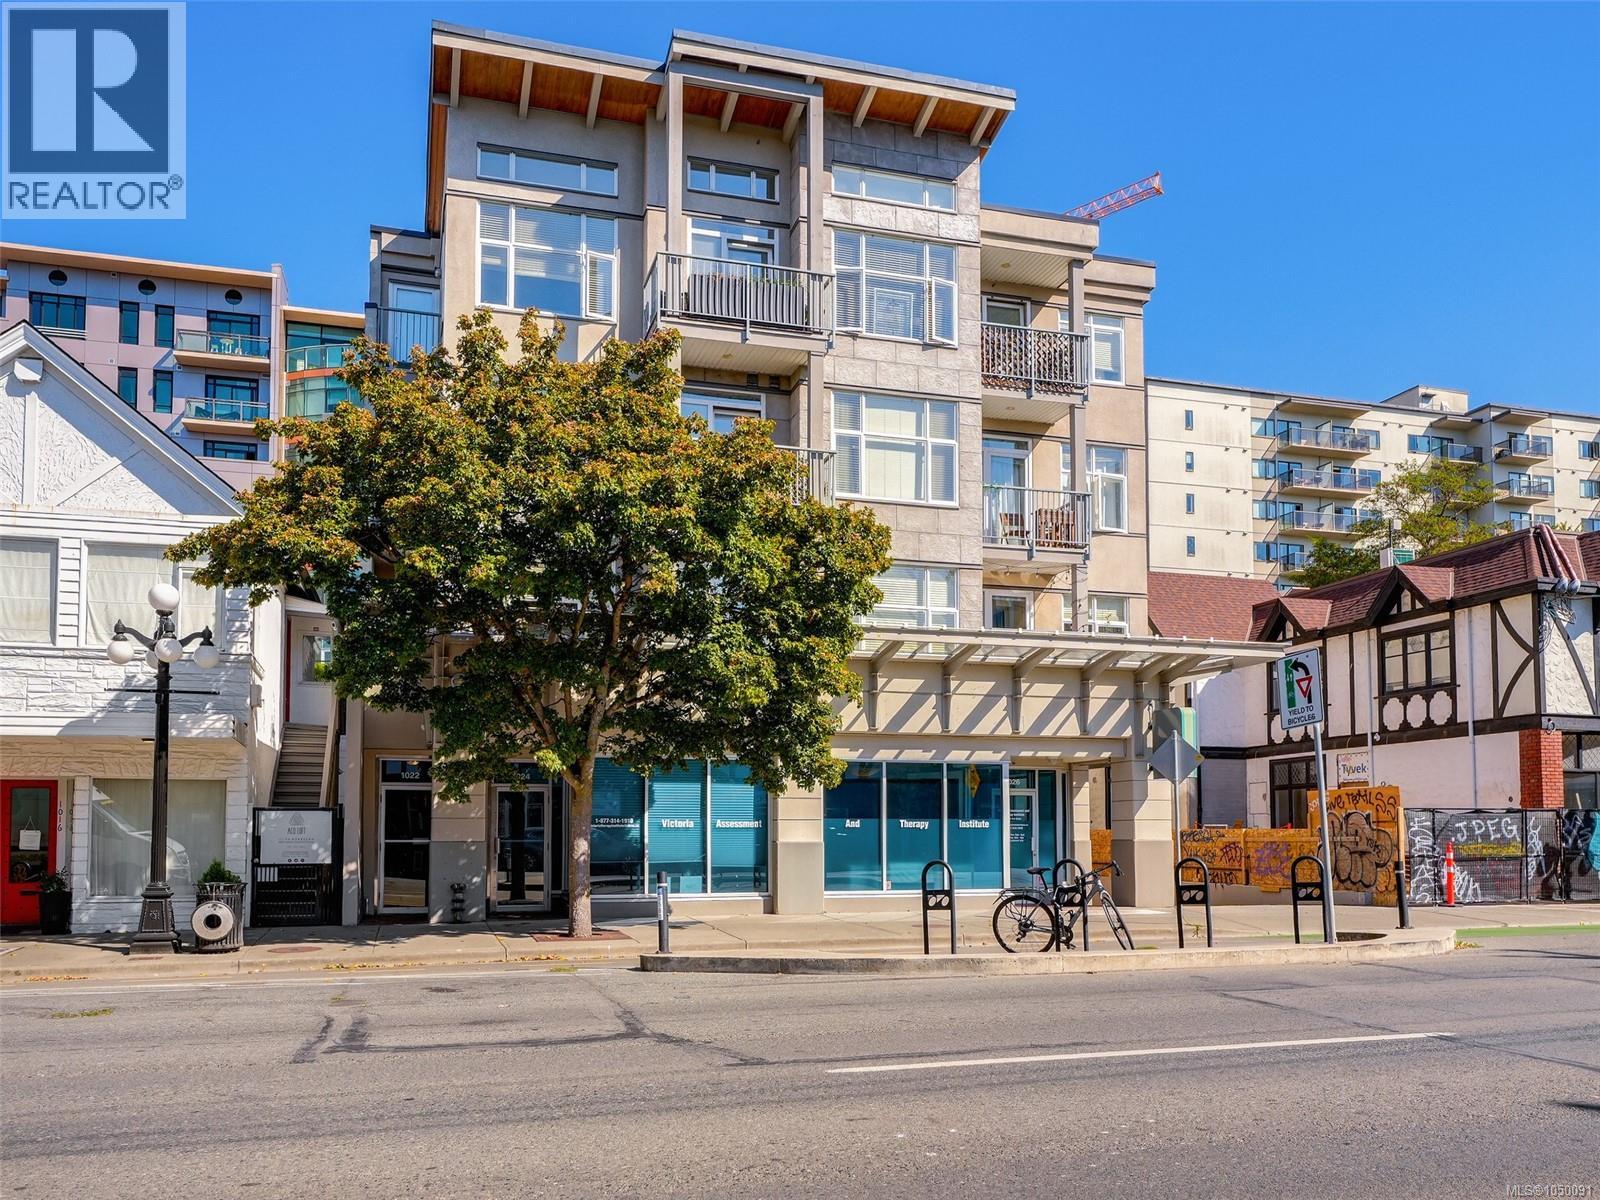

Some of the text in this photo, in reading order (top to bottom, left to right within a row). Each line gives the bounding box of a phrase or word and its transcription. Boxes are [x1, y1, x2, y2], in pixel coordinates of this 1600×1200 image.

[1288, 704, 1314, 717] YIELD TO
[1287, 713, 1316, 726] BICYCLES
[400, 771, 420, 780] 1022
[1341, 763, 1367, 776] Tyvek
[661, 818, 990, 830] Victoria Assessment And Therapy Institute
[1454, 816, 1521, 843] JPEG
